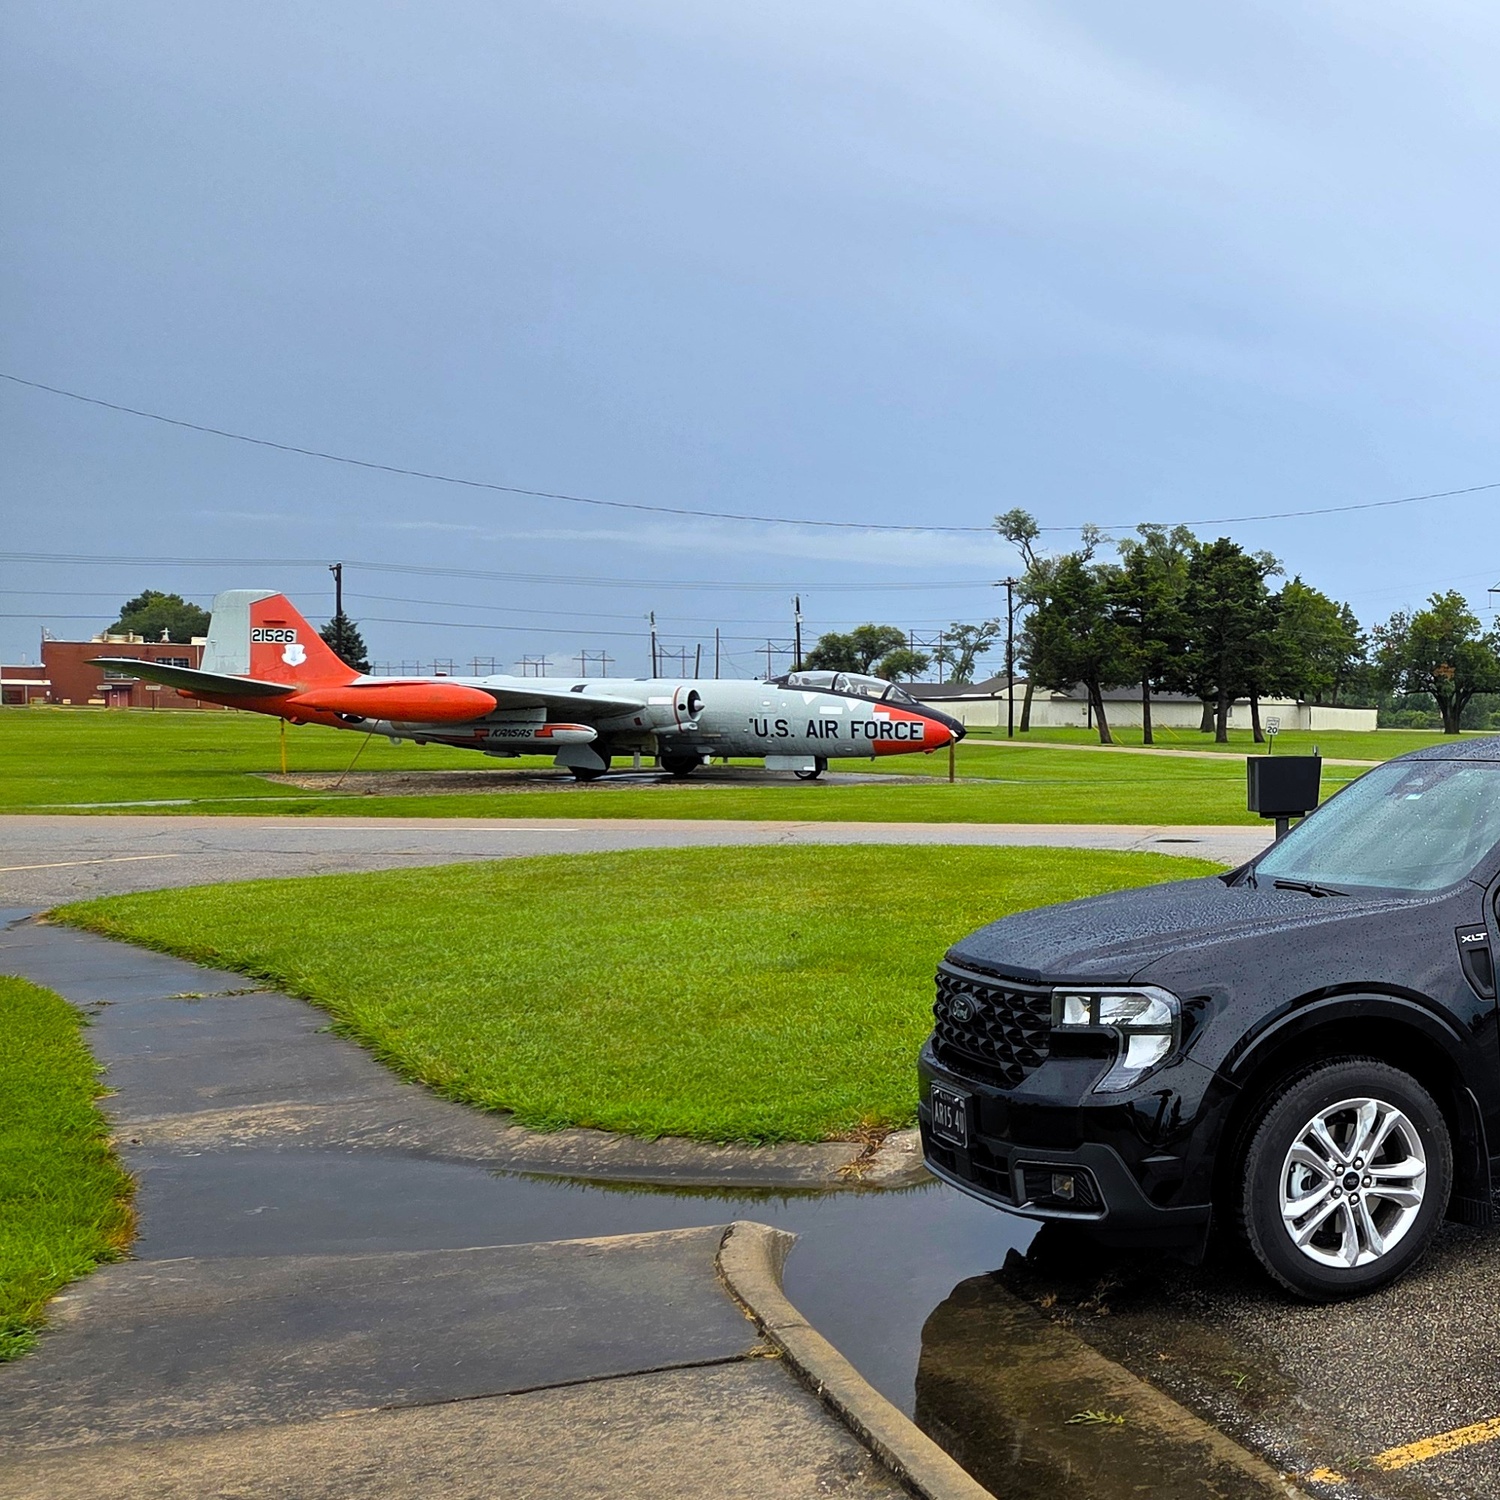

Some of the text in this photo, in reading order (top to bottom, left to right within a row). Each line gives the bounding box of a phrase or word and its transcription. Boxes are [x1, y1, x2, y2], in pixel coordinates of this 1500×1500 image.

[252, 628, 295, 642] 21526
[491, 728, 534, 738] KANSAS
[754, 718, 924, 740] U.S. AIR FORCE
[1266, 725, 1278, 734] 20
[1461, 932, 1487, 943] XLT
